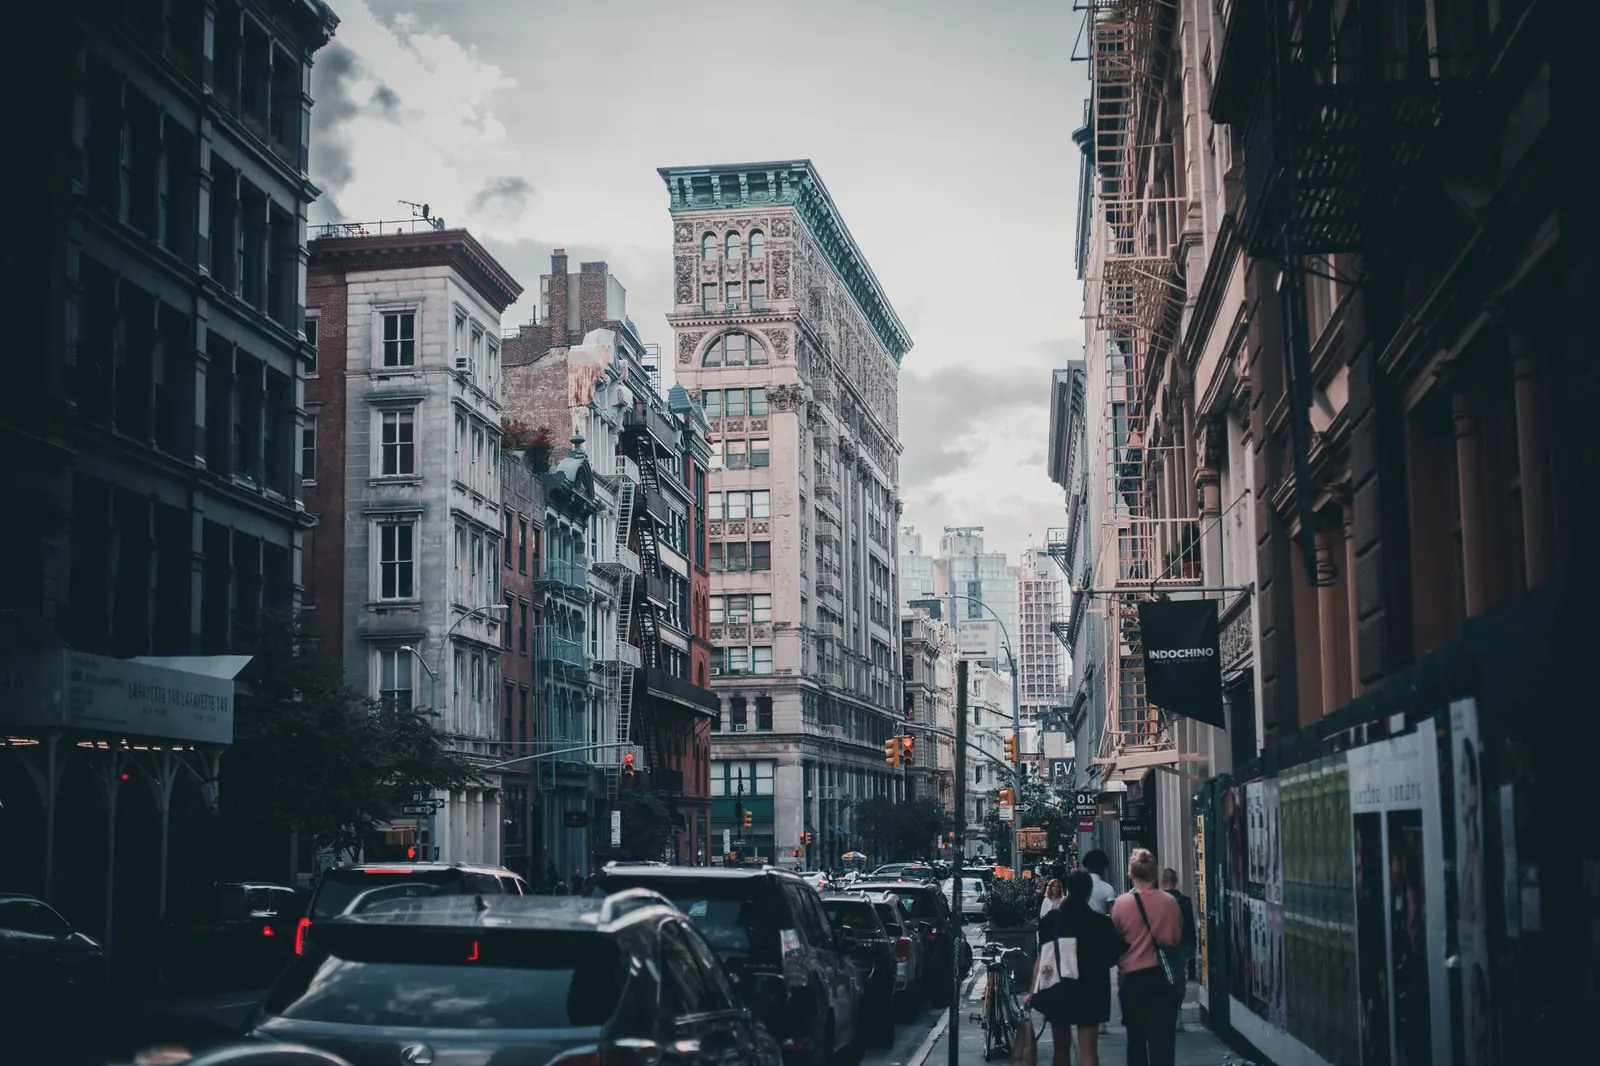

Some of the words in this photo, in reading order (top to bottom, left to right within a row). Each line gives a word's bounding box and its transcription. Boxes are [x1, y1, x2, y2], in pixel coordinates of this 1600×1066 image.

[1149, 648, 1214, 659] INDOCHINO
[128, 684, 165, 704] LAFAYETTE
[167, 688, 180, 706] 148
[181, 691, 215, 711] LAFAYETTE
[1077, 794, 1098, 804] OK
